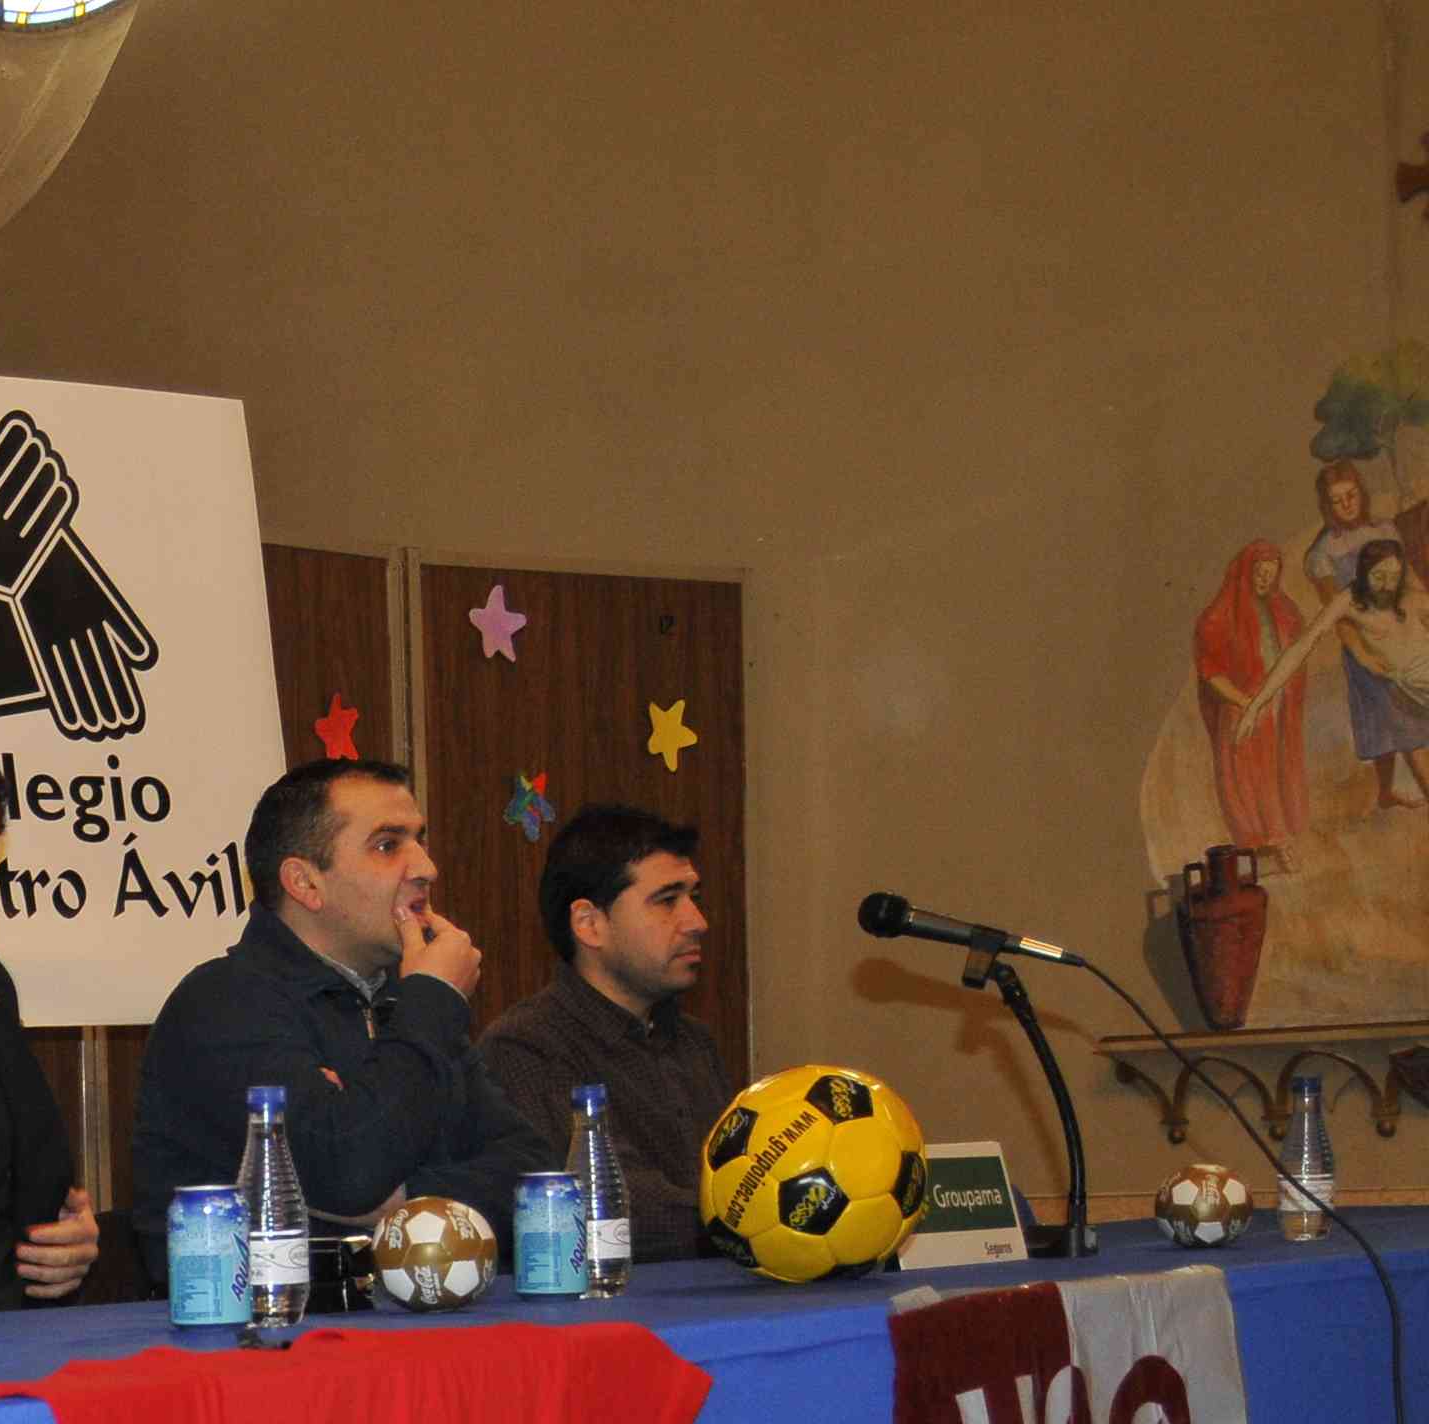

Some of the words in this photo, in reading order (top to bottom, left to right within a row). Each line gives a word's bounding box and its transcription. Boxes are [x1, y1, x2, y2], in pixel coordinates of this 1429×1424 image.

[1, 753, 172, 844] legio
[114, 832, 249, 919] Ávil
[932, 1183, 1003, 1213] Groupama
